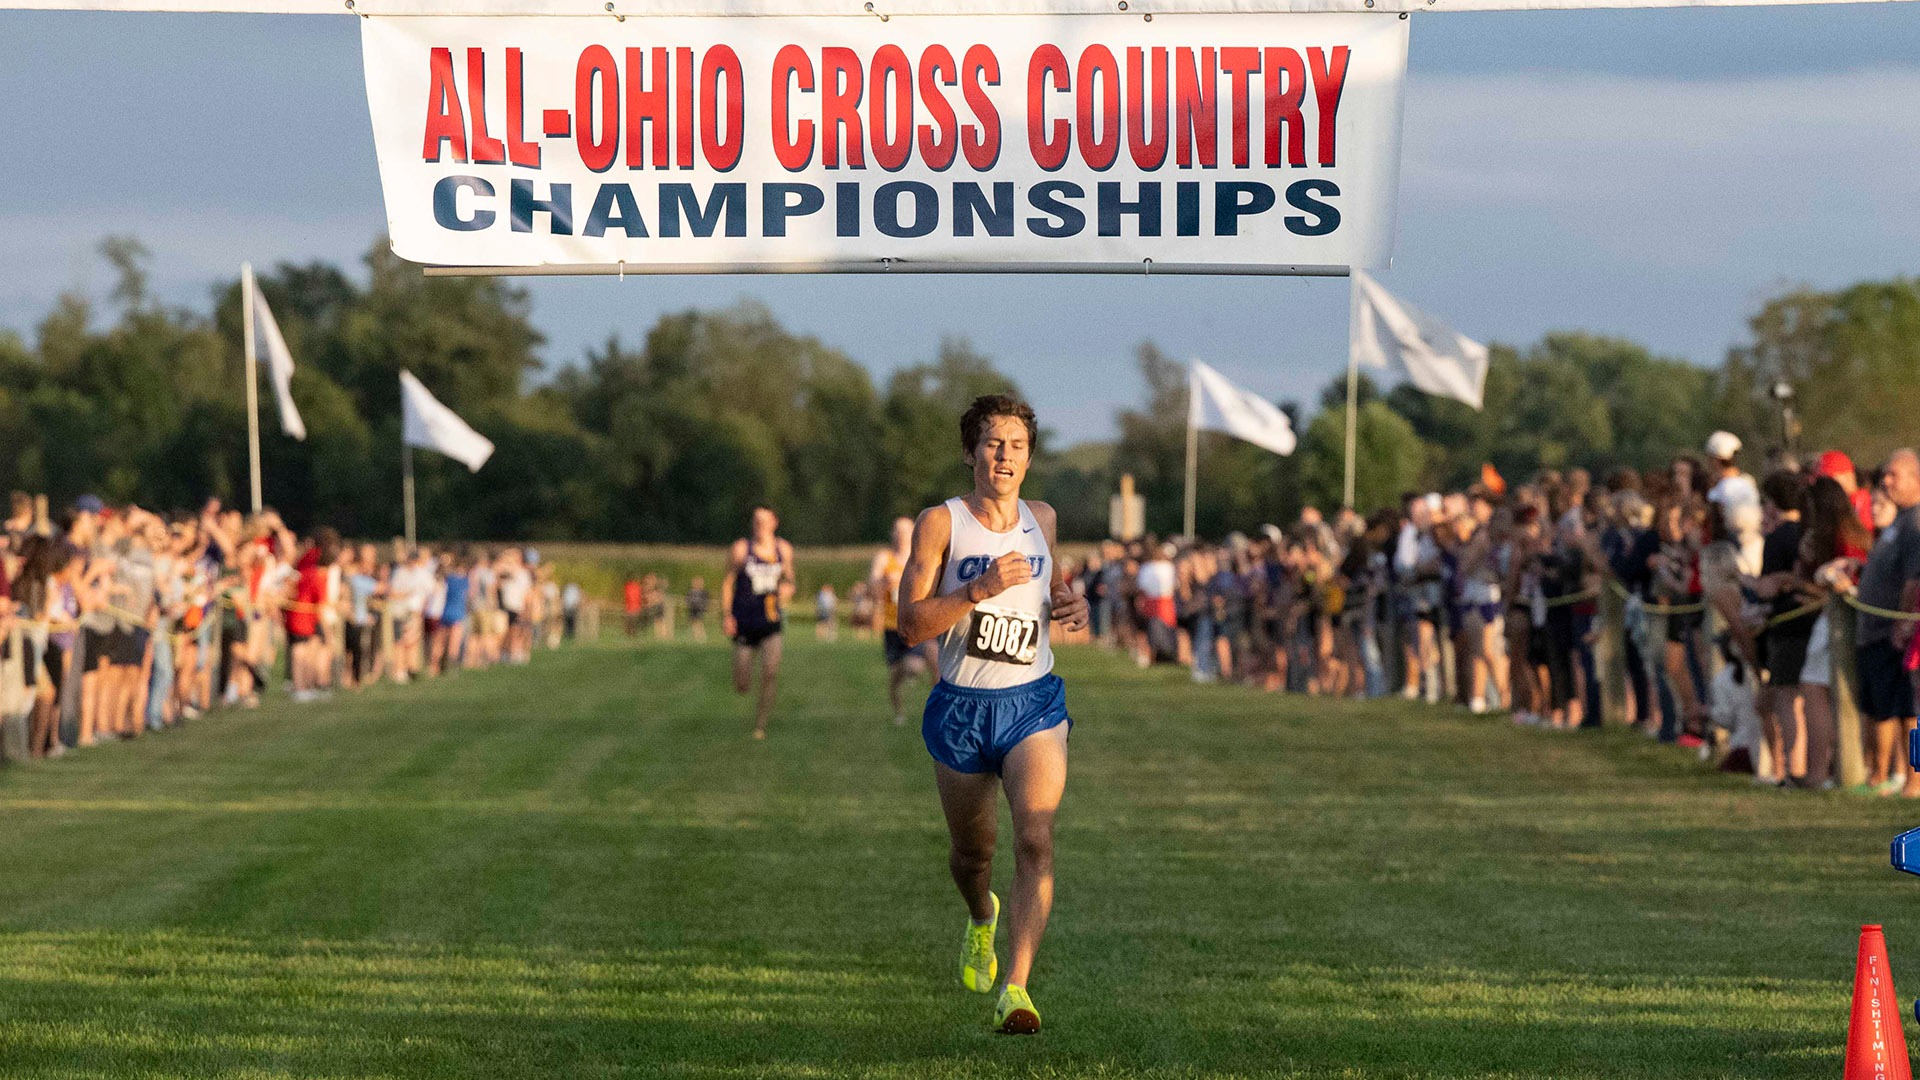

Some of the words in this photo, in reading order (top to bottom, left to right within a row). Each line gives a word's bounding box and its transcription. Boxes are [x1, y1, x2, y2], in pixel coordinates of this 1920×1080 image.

[422, 43, 744, 173] ALL-OHIO
[771, 43, 1001, 172] CROSS
[1027, 43, 1351, 172] COUNTRY
[432, 175, 1342, 238] CHAMPIONSHIPS
[956, 554, 1046, 583] CU
